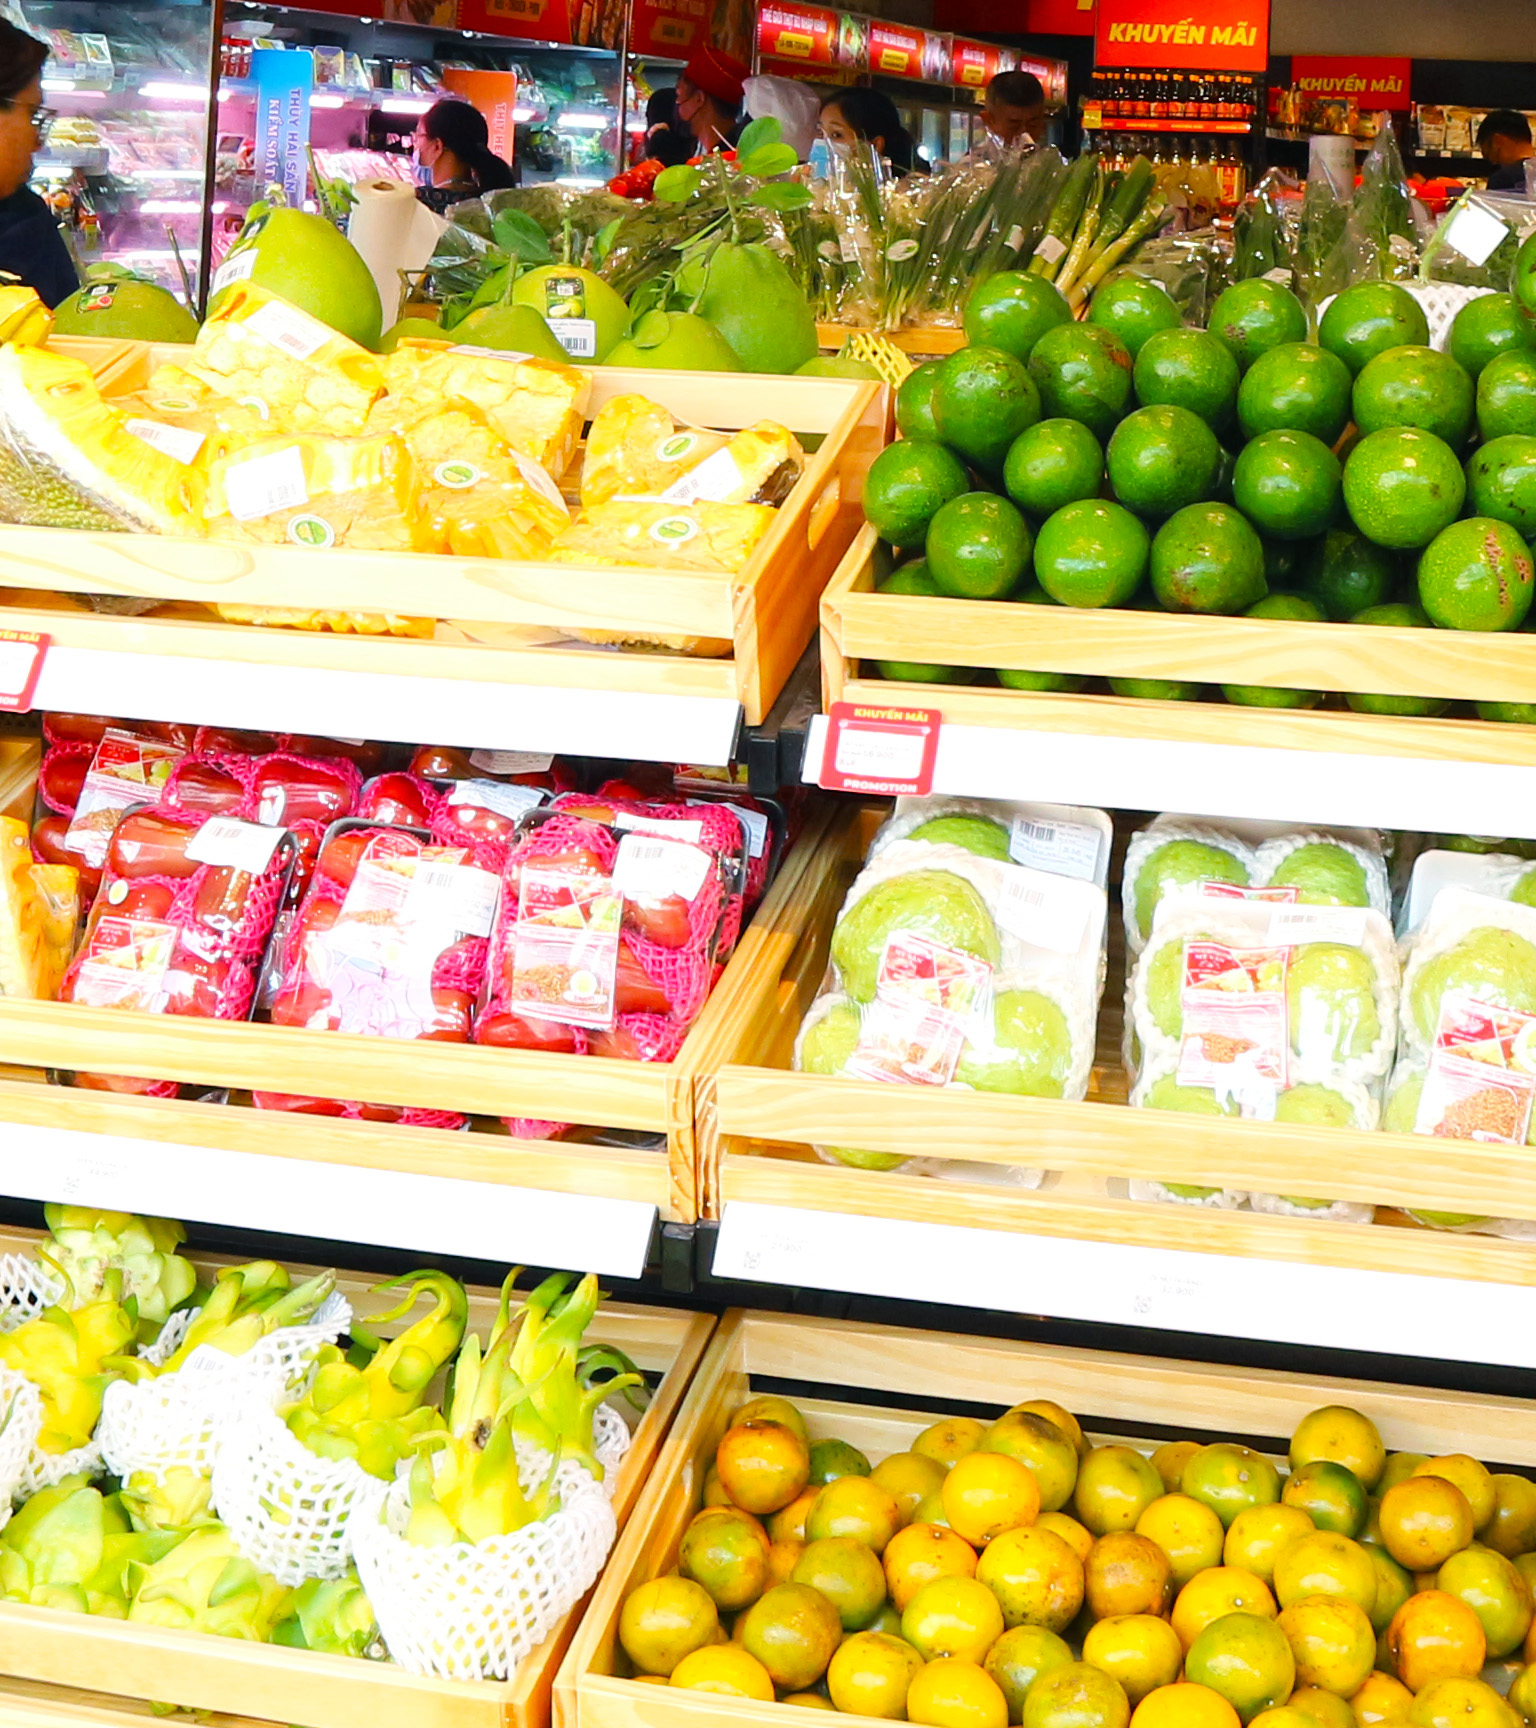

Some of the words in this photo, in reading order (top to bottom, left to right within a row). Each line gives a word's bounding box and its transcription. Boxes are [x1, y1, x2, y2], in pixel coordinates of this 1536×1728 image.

[1108, 18, 1205, 46] KHUYẾN
[1210, 20, 1257, 47] MÃI
[1299, 73, 1367, 92] KHUYẾN
[1370, 75, 1403, 92] MÃI
[19, 633, 41, 642] MÃI
[854, 707, 903, 720] KHUYẾN
[906, 712, 929, 722] MÃI
[843, 778, 918, 793] PROMOTION
